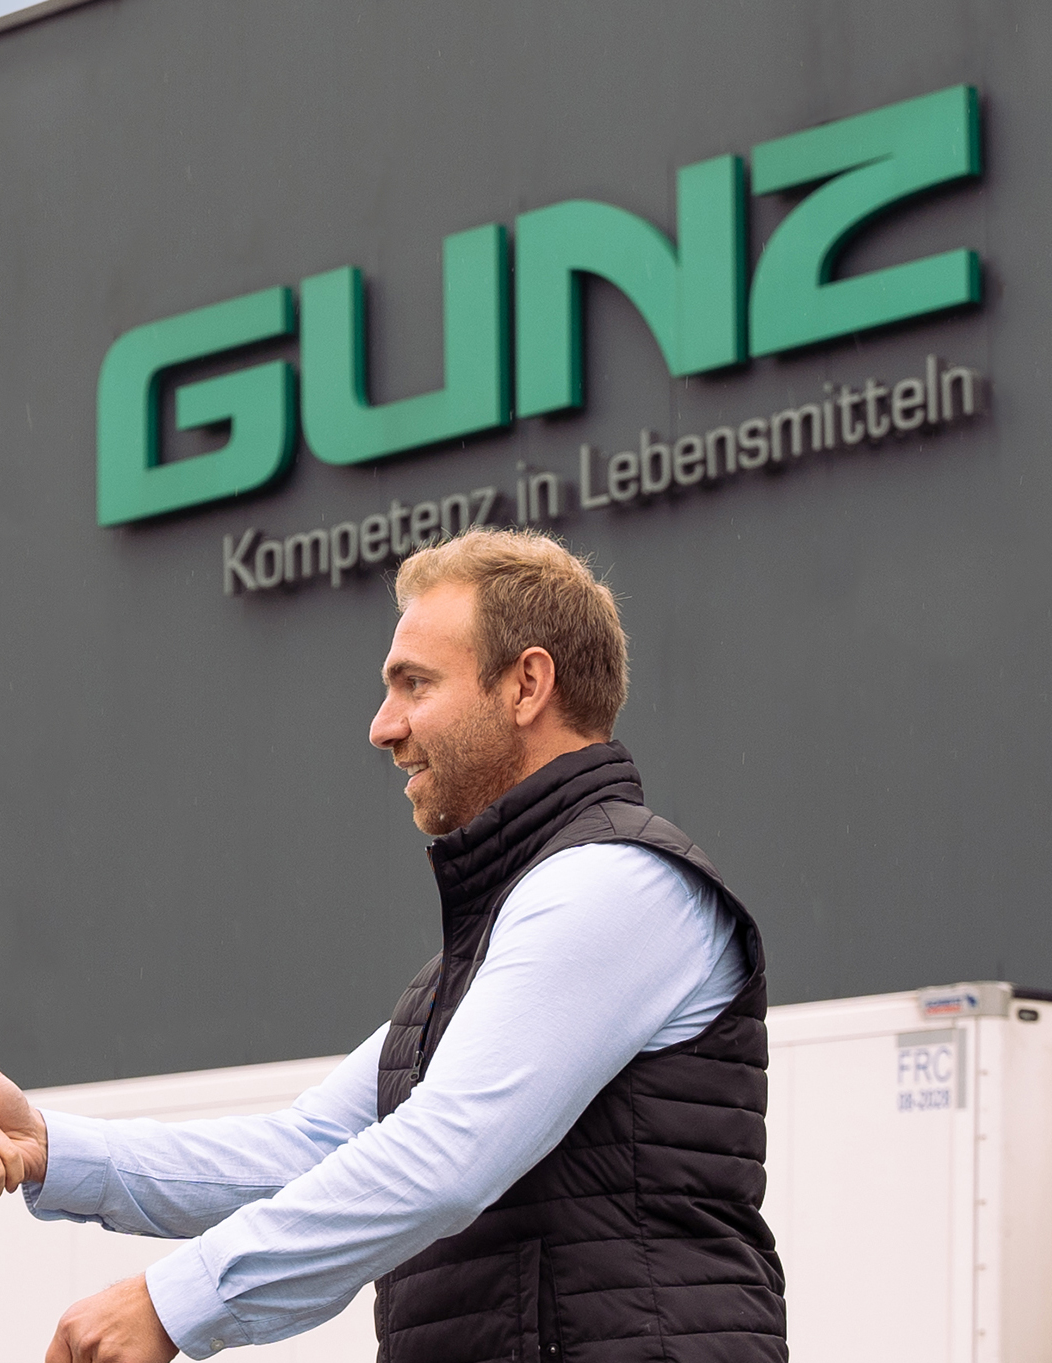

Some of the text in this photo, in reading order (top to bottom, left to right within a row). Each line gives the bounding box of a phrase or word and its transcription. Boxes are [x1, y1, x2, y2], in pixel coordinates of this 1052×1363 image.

[97, 83, 980, 526] GUNZ
[223, 353, 975, 595] Kompetenz in Lebensmitteln
[897, 1046, 952, 1086] FRC
